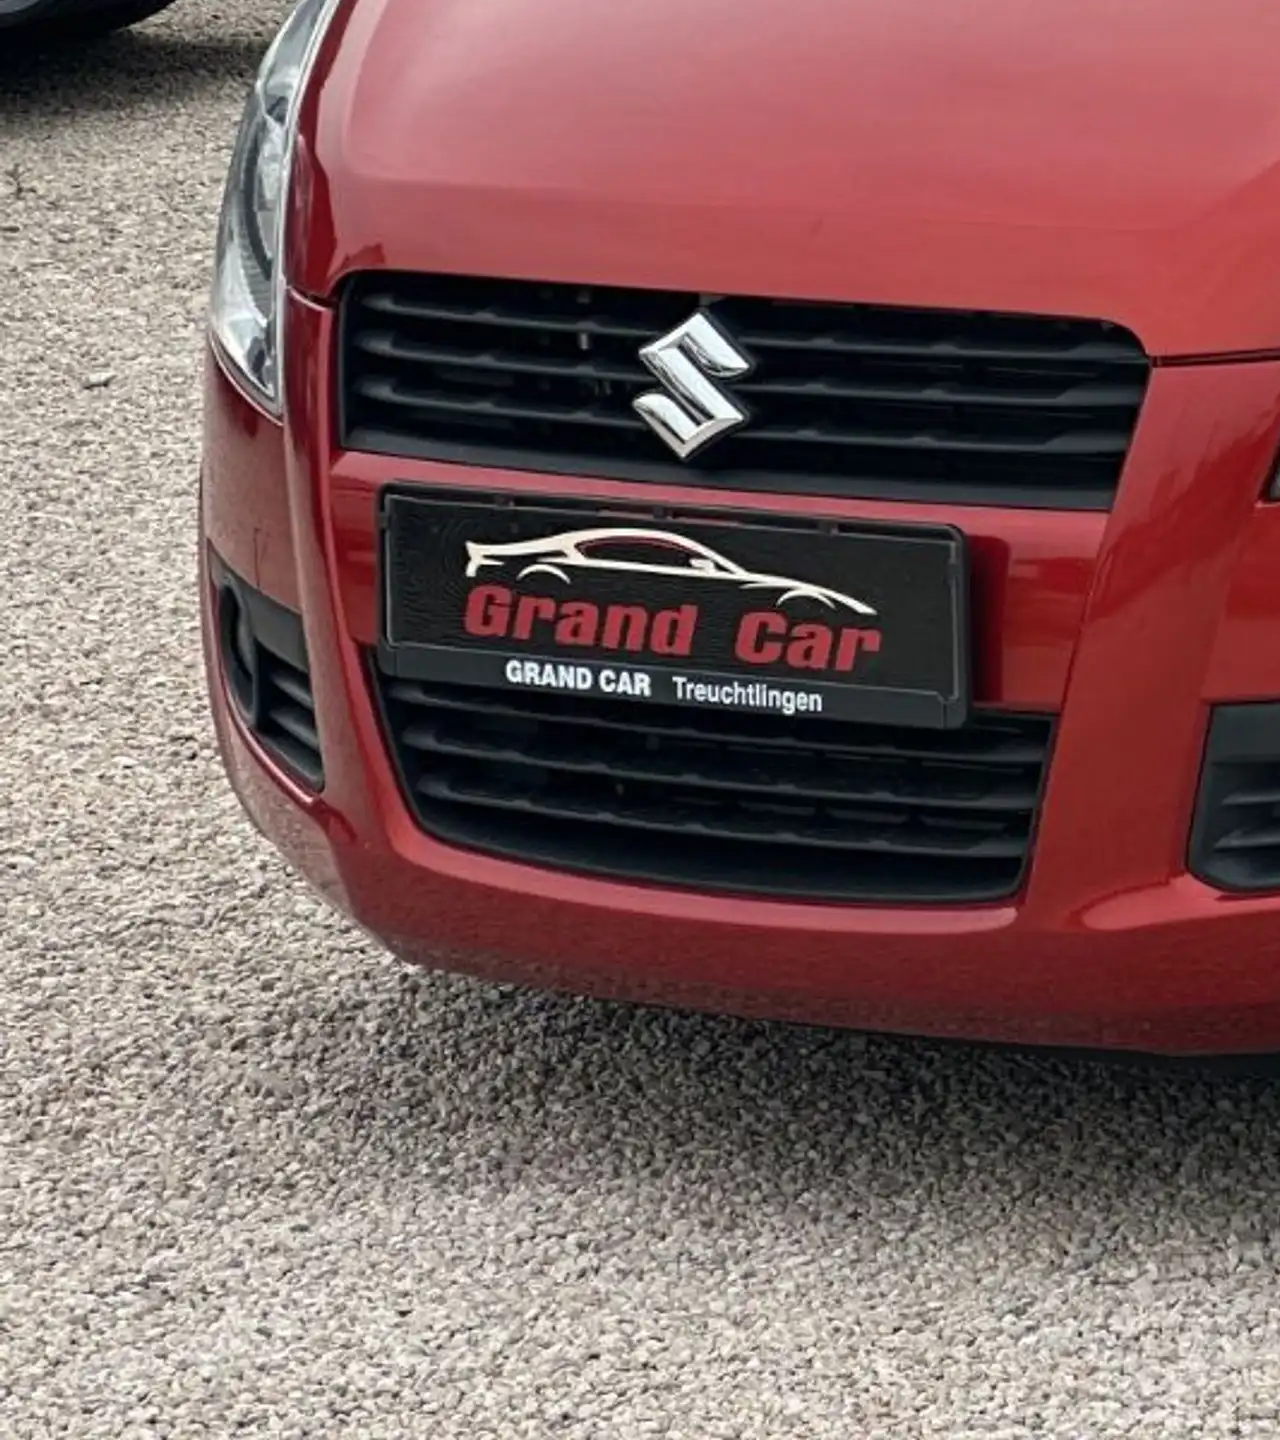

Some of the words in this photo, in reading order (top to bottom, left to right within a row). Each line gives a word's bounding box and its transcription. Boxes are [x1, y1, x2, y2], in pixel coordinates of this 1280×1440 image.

[464, 583, 699, 657] Grand
[734, 610, 882, 672] Car
[505, 658, 592, 690] GRAND
[599, 669, 651, 697] CAR
[672, 675, 823, 715] Treuchtlingen
